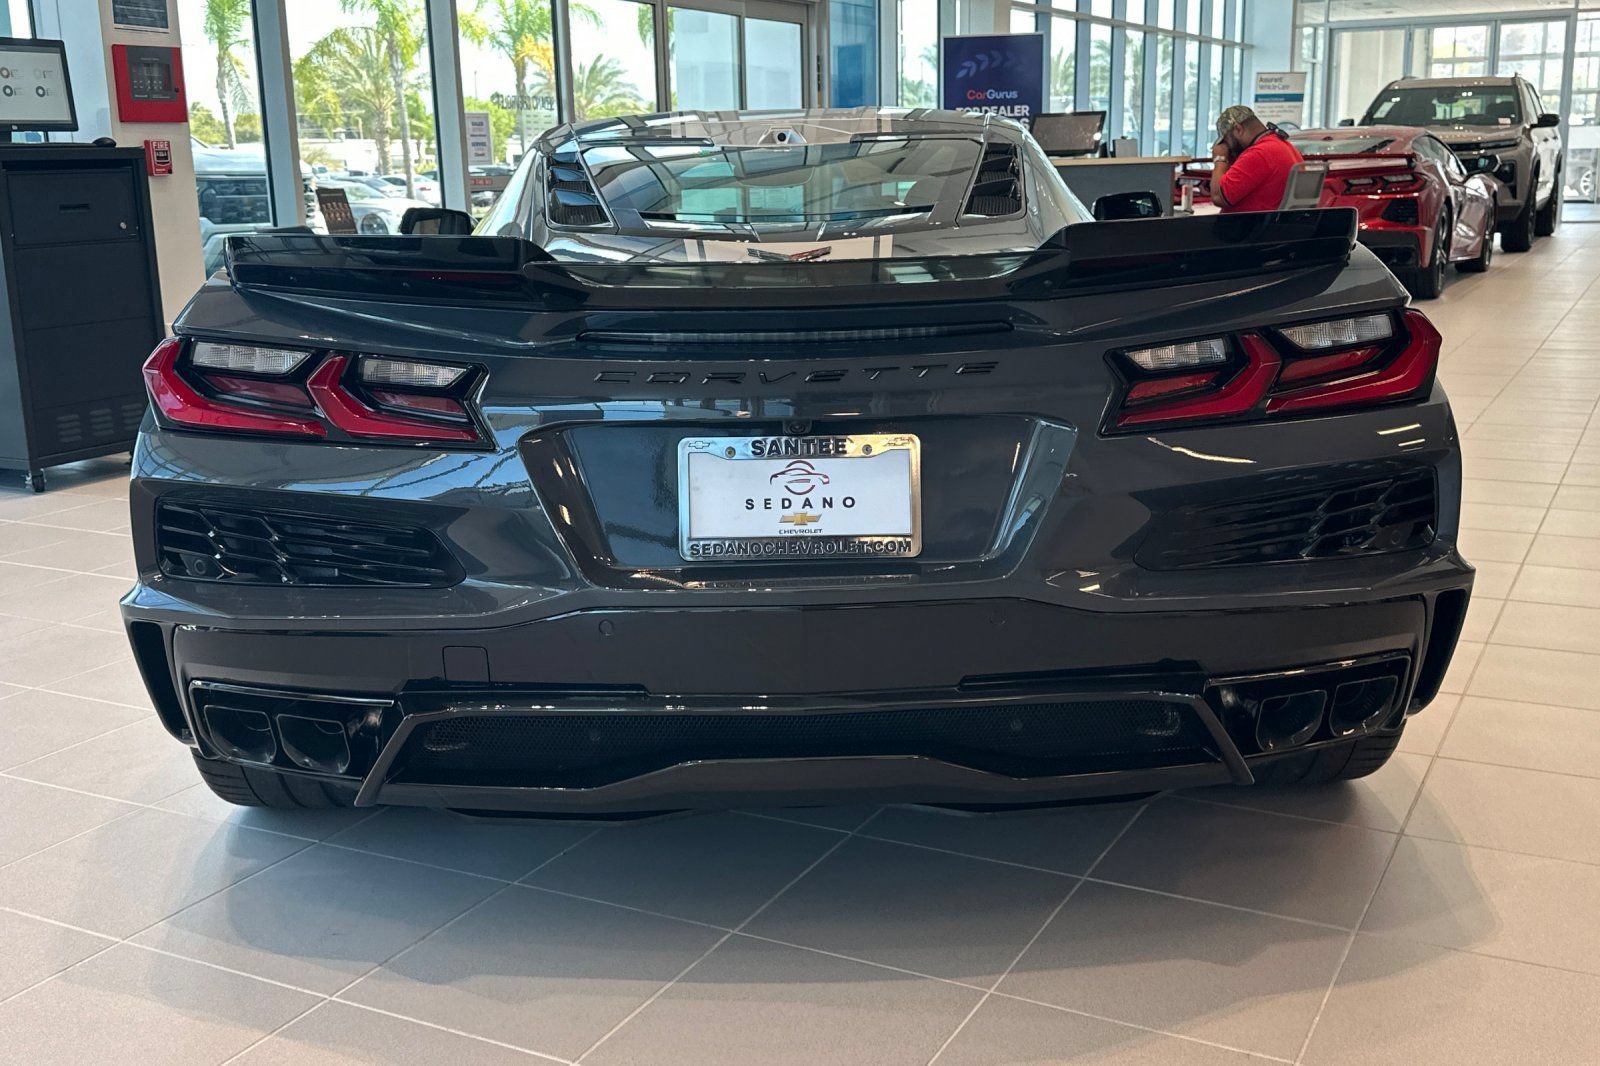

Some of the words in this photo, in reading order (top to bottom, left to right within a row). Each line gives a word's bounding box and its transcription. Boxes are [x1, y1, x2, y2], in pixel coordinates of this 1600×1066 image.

[967, 89, 1018, 100] CarGurus
[981, 105, 1030, 117] DEALER
[152, 141, 169, 150] FIRE
[593, 361, 1000, 384] CORVETTE
[751, 437, 848, 458] SANTEE
[744, 496, 856, 510] SEDANO
[690, 540, 912, 556] SEDANOCHEVROLET.COM
